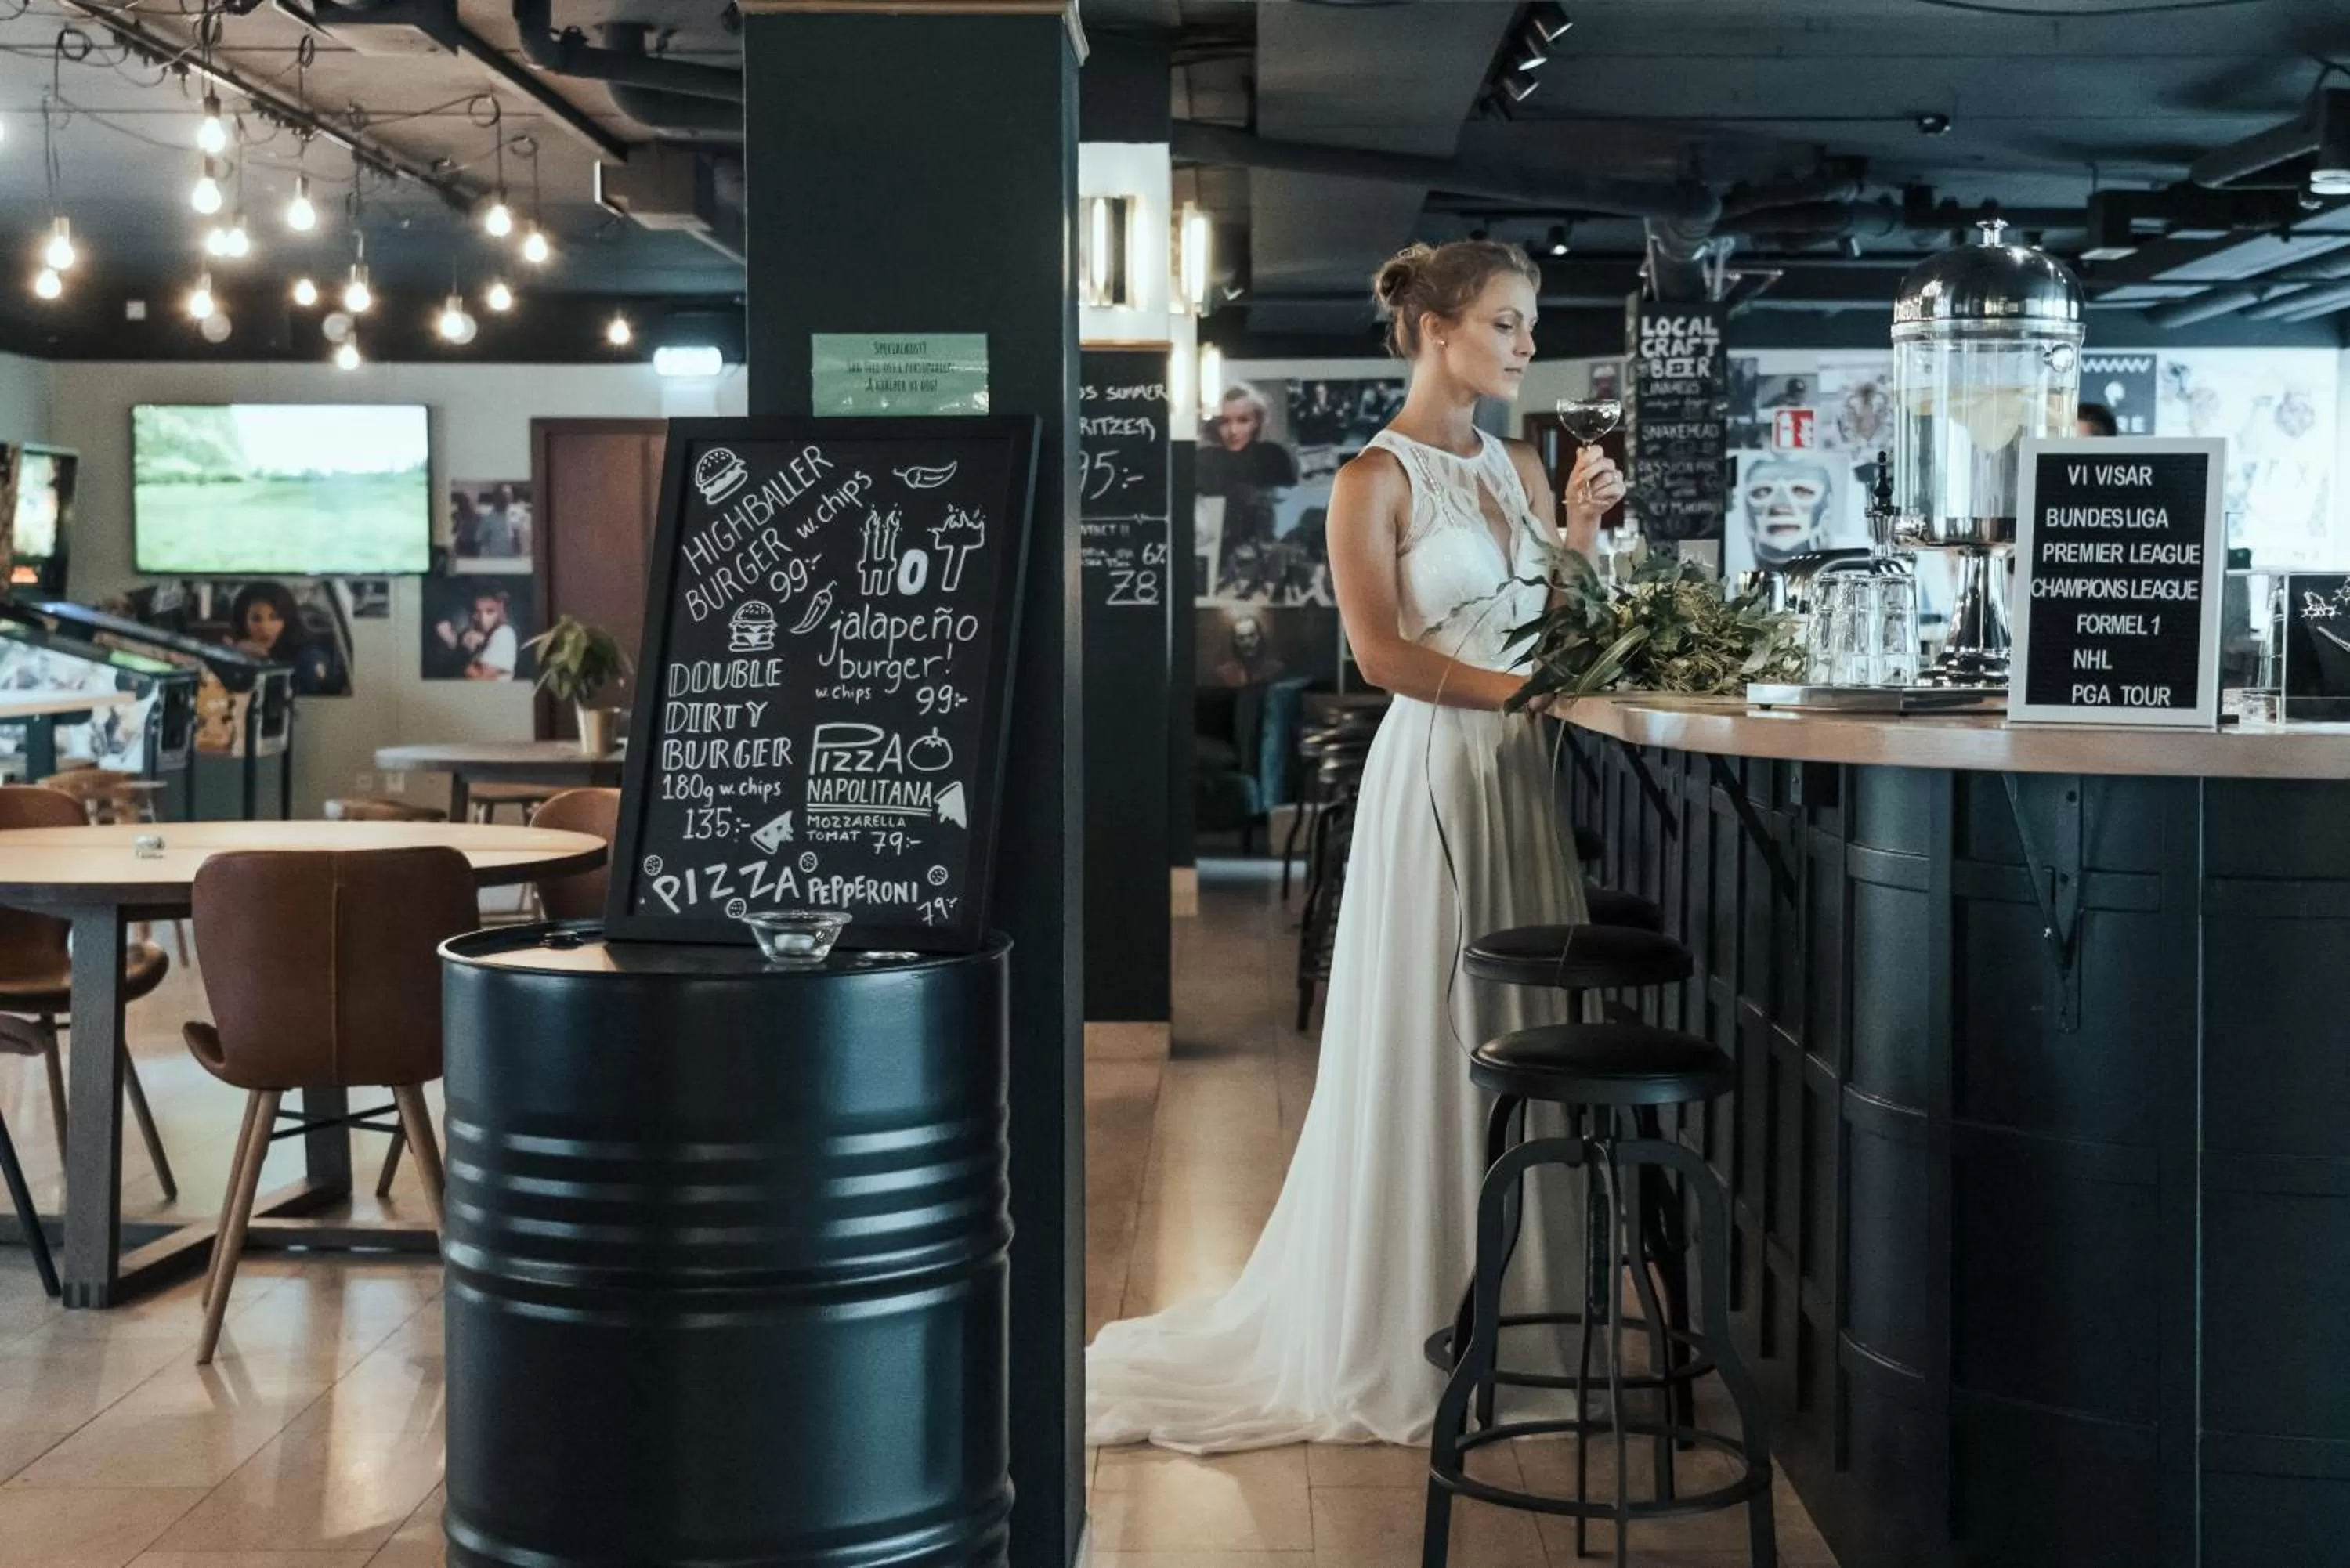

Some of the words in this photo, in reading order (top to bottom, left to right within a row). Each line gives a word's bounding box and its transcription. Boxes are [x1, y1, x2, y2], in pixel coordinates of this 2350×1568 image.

[1641, 316, 1719, 337] LOCAL
[1640, 338, 1720, 357] CRAFT
[1650, 357, 1711, 378] BEER
[1106, 384, 1170, 402] SUMMER
[2067, 464, 2088, 486] VI
[2095, 464, 2153, 486] VISAR
[683, 446, 833, 575] HIGHBALLER
[2046, 508, 2169, 529] BUNDESLIGA
[858, 505, 985, 595] HOT
[2043, 543, 2124, 565] PREMIER
[2129, 543, 2201, 565] LEAGUE
[686, 527, 793, 622] BURGER
[771, 553, 822, 604] 99:-
[2030, 578, 2128, 599] CHAMPIONS
[2130, 580, 2199, 601] LEAGUE
[819, 603, 978, 666] jalapeño
[2077, 614, 2148, 635] FORMEL
[2149, 616, 2160, 636] 1
[839, 642, 953, 693] burger!
[2073, 649, 2113, 670] NHL
[667, 659, 783, 698] DOUBLE
[915, 684, 968, 715] 99:-
[2072, 684, 2111, 705] PGA
[2120, 685, 2171, 706] TOUR
[665, 701, 768, 734] DIRTY
[661, 736, 794, 772] BURGER
[809, 723, 903, 775] PIZZA
[662, 773, 714, 807] 180g
[807, 778, 932, 807] NAPOLITANA
[807, 815, 906, 828] MOZZARELLA
[806, 830, 861, 842] TOMAT
[870, 831, 922, 856] 79:-
[653, 860, 800, 914] PIZZA
[808, 875, 918, 909] PEPPERONI
